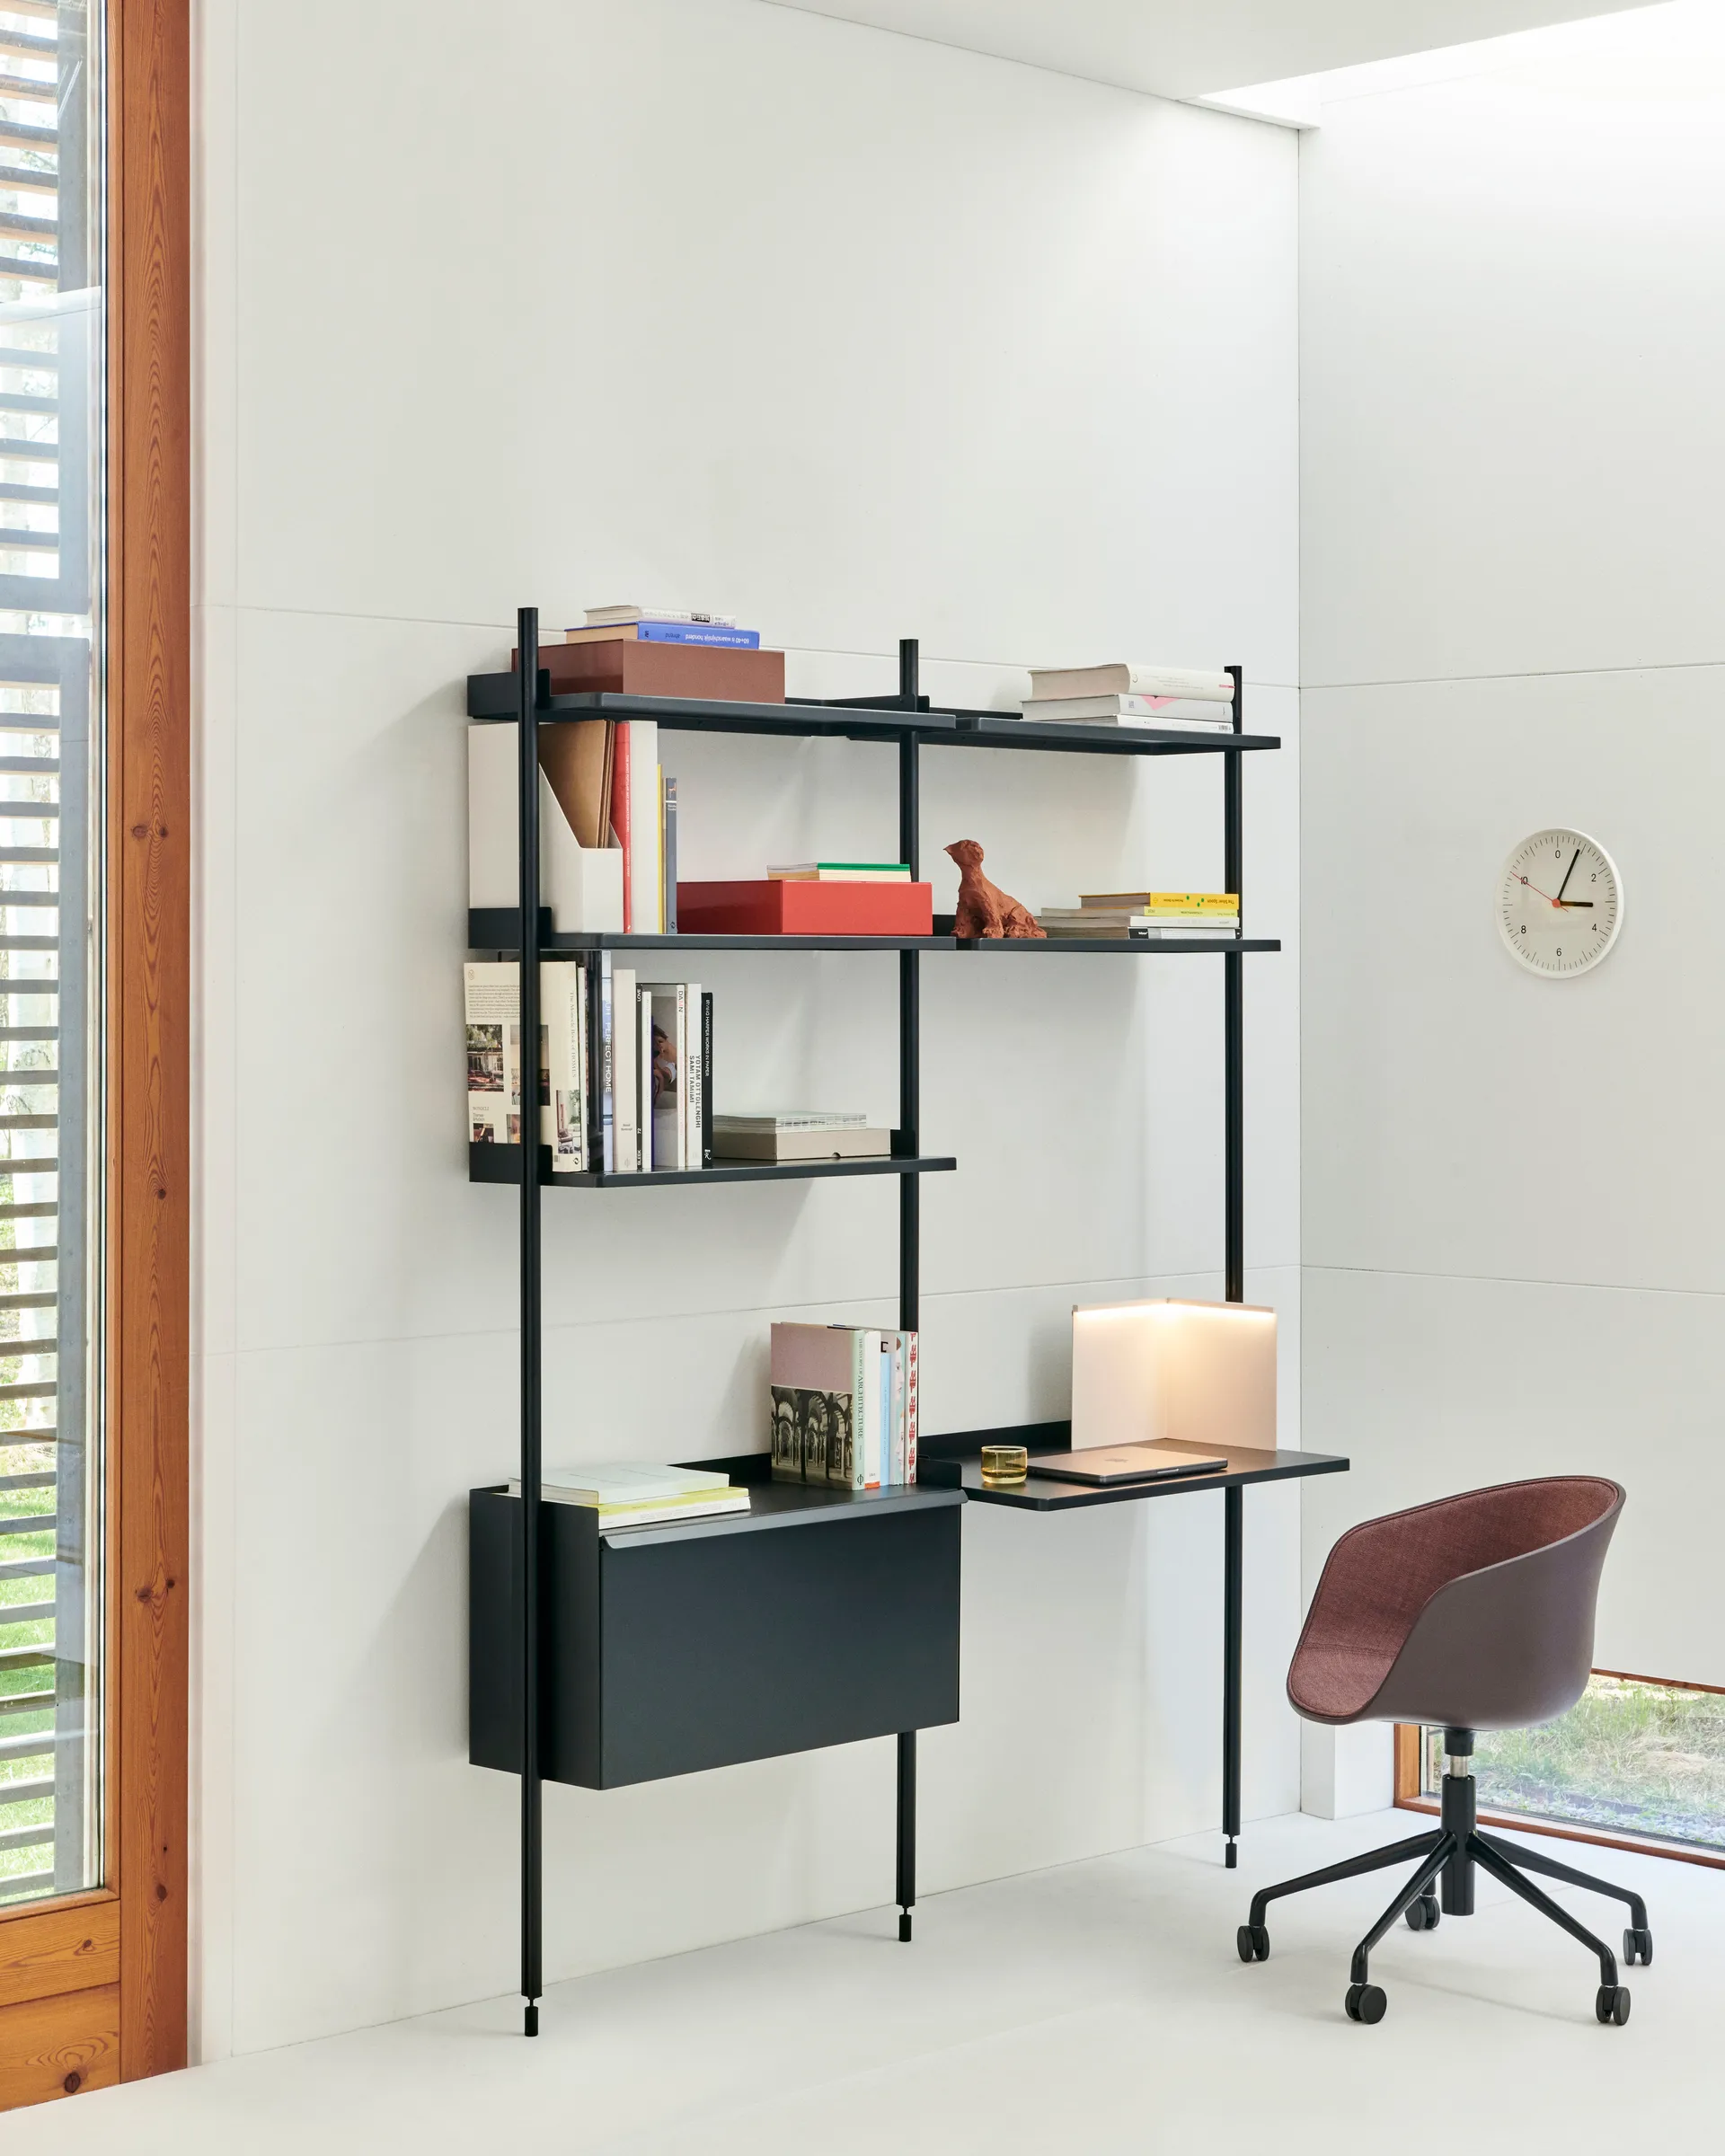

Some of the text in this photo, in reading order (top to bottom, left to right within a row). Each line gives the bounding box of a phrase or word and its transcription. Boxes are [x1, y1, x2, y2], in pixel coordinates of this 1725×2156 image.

[685, 633, 703, 641] honderd
[1555, 850, 1561, 859] 0
[1590, 873, 1597, 882] 2
[1520, 925, 1526, 934] 8
[1591, 923, 1597, 932] 4
[1556, 948, 1562, 957] 6
